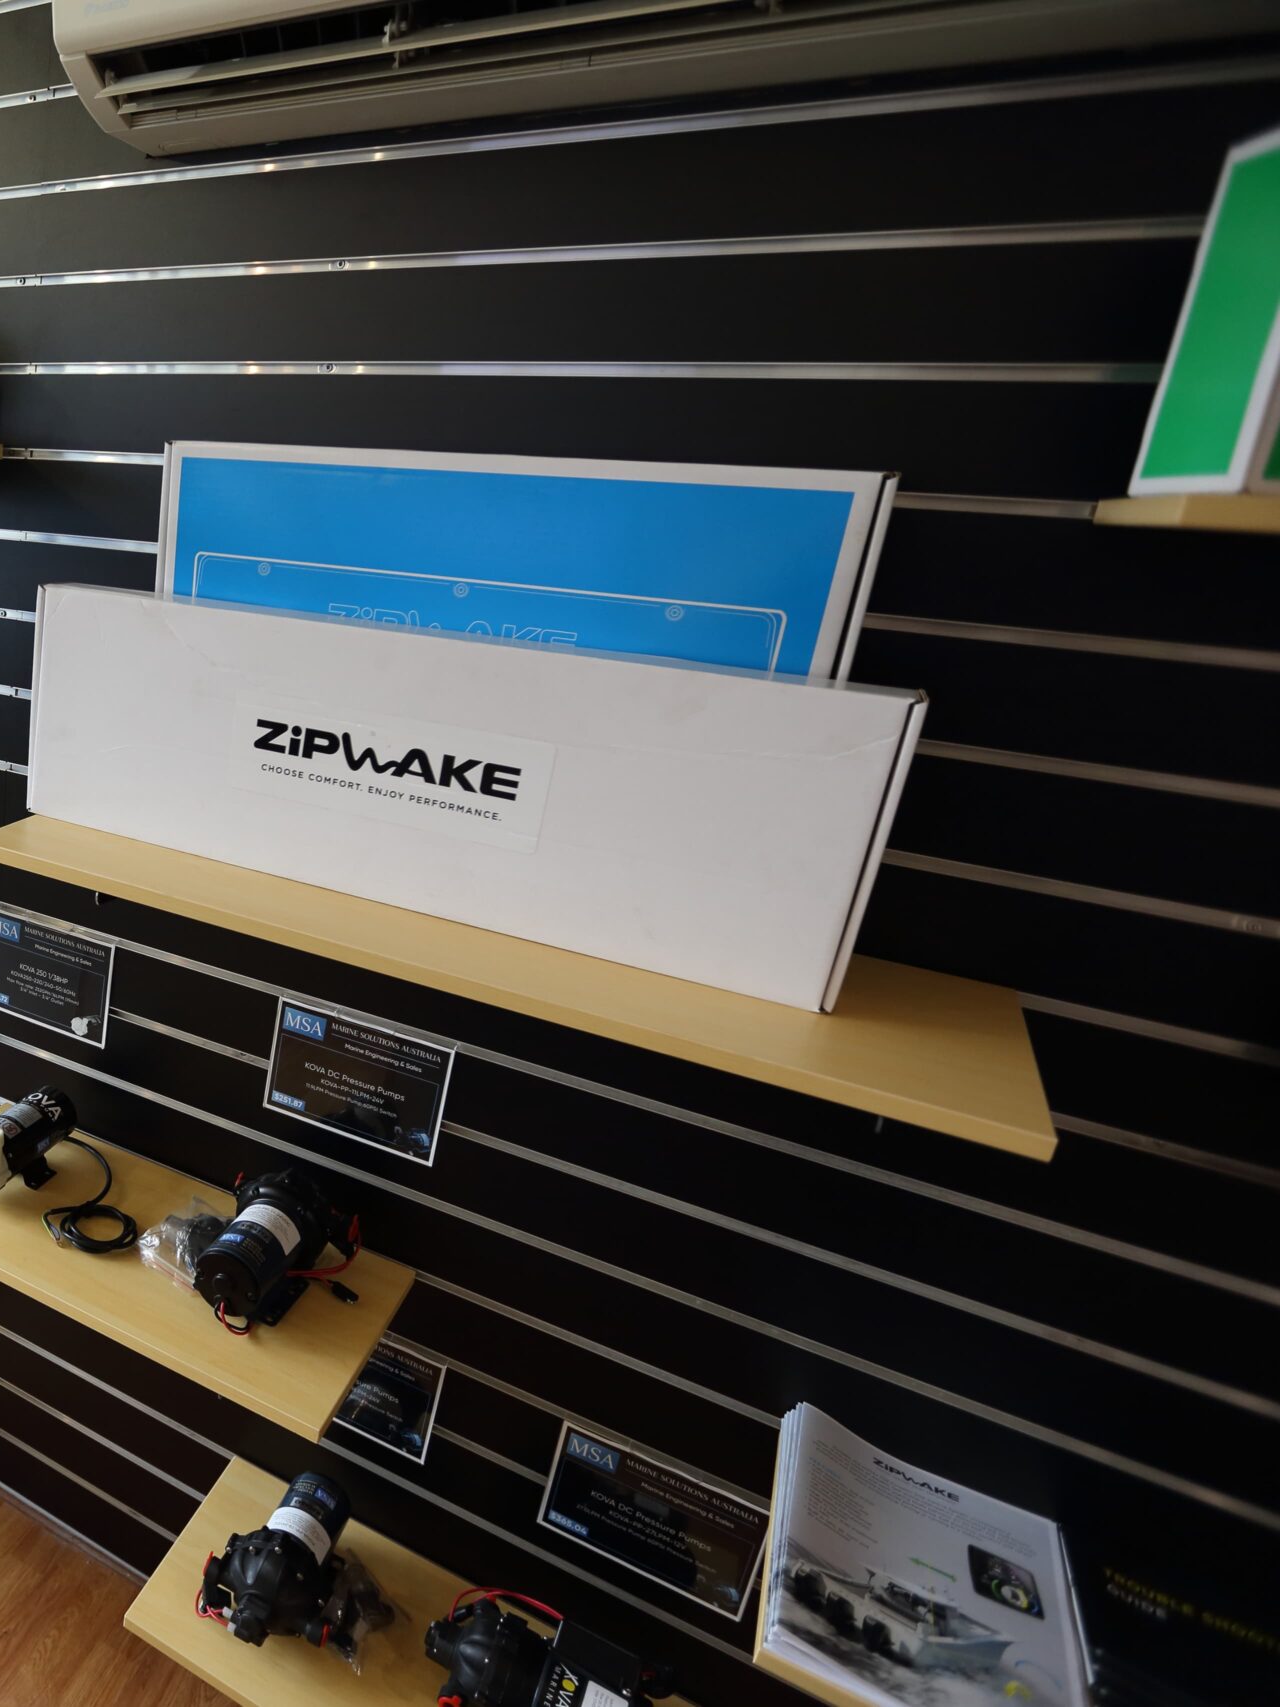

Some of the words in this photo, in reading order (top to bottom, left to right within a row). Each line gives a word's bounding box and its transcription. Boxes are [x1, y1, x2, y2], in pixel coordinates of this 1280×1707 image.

[260, 763, 305, 779] CHOOSE
[308, 773, 363, 792] COMFORT.
[368, 785, 405, 801] ENJOY
[409, 794, 502, 822] PERFORMANCE.
[24, 926, 44, 938] MARINE
[45, 932, 75, 948] SOLUTIONS
[76, 941, 106, 957] AUSTRALIA
[34, 943, 49, 953] Marine
[49, 948, 75, 962] Engineering
[20, 963, 35, 974] KOVA
[36, 969, 47, 978] 250
[285, 1012, 323, 1036] MSA
[331, 1022, 359, 1037] MARINE
[360, 1031, 400, 1050] SOLUTIONS
[401, 1045, 441, 1063] AUSTRALIA
[344, 1043, 364, 1055] Marine
[365, 1048, 399, 1067] Engineering
[406, 1062, 422, 1073] Sales
[305, 1061, 326, 1075] KOVA
[327, 1068, 341, 1079] DC
[342, 1074, 376, 1091] Pressure
[377, 1085, 406, 1102] Pumps
[570, 1438, 614, 1470] MSA
[626, 1458, 658, 1478] MARINE
[660, 1473, 709, 1501] SOLUTIONS
[712, 1497, 759, 1524] AUSTRALIA
[641, 1481, 665, 1496] Marine
[665, 1491, 707, 1517] Engineering
[715, 1515, 735, 1529] Sales
[590, 1489, 616, 1507] KOVA
[618, 1502, 633, 1515] DC
[635, 1510, 676, 1536] Pressure
[678, 1529, 712, 1552] Pumps
